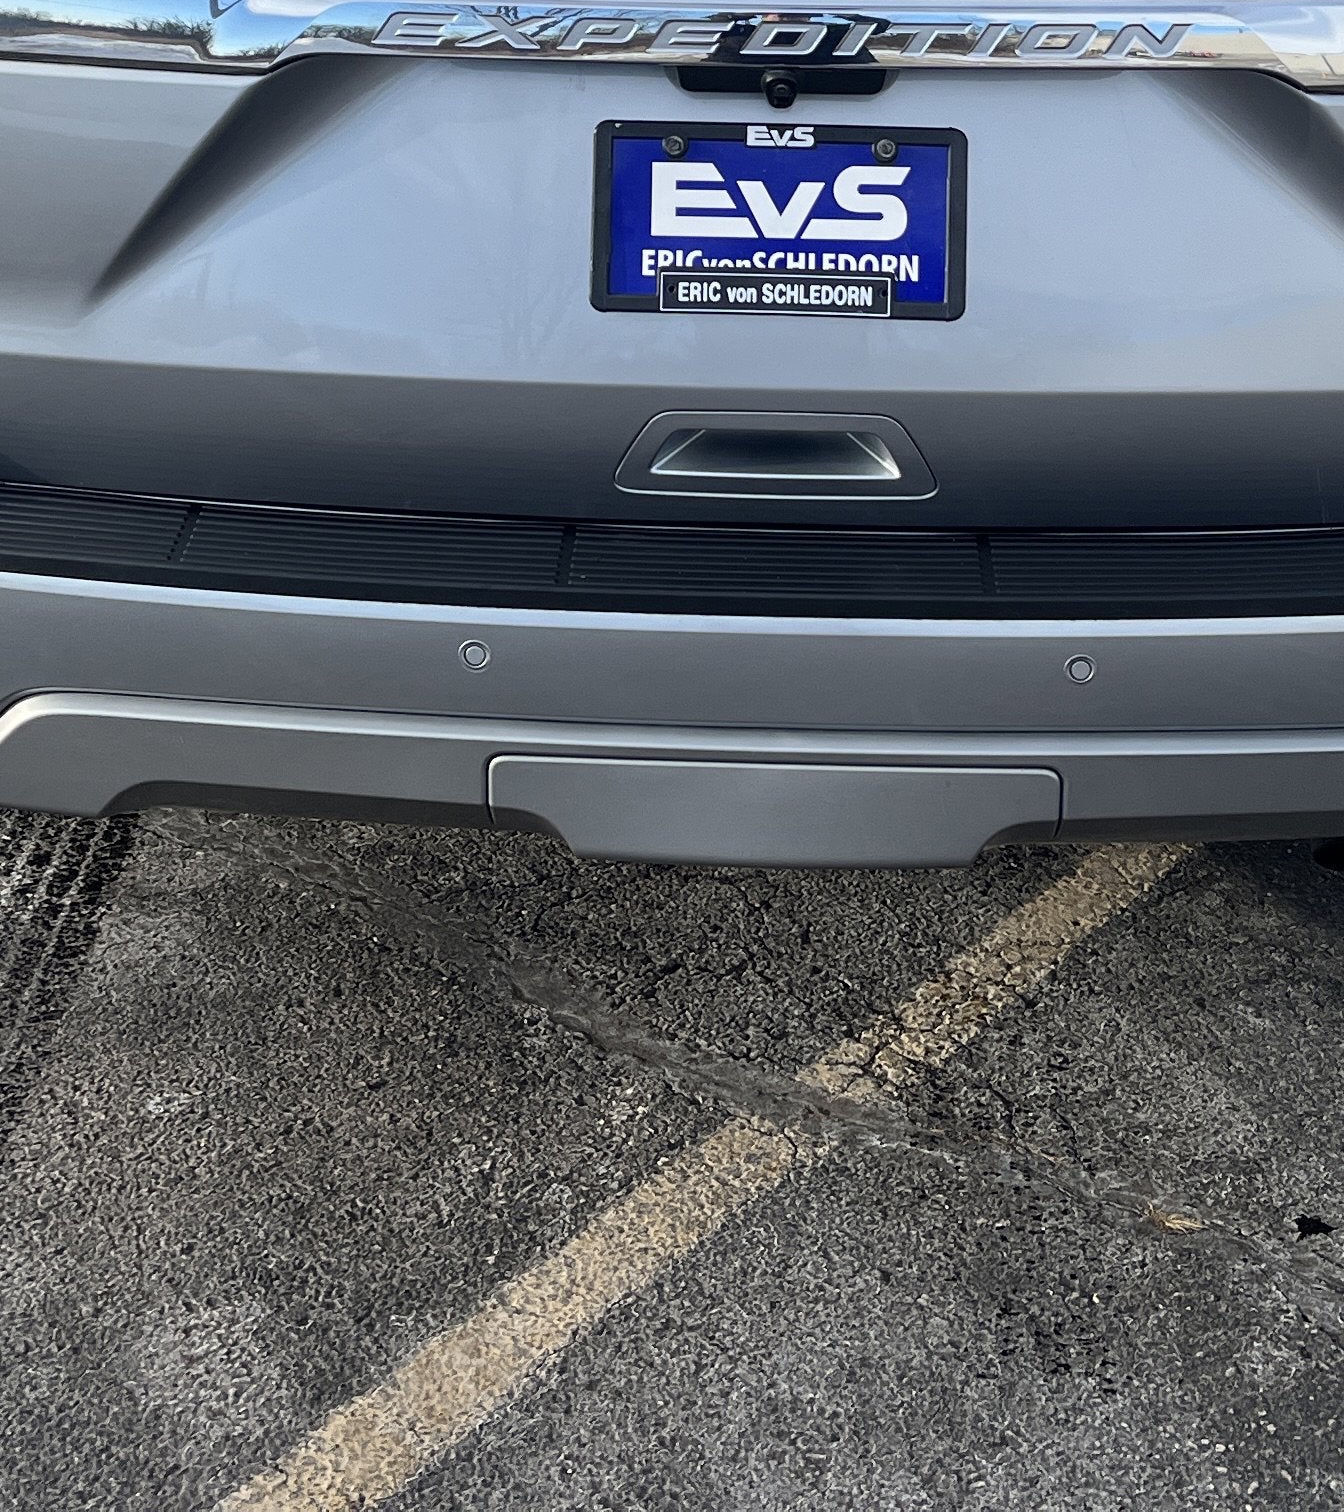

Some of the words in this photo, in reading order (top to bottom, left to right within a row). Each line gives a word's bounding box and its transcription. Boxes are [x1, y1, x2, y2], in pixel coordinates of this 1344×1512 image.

[370, 10, 1196, 60] EXPEDITION
[677, 281, 722, 303] ERIC
[726, 286, 758, 304] von
[761, 282, 873, 307] SCHLEDORN
